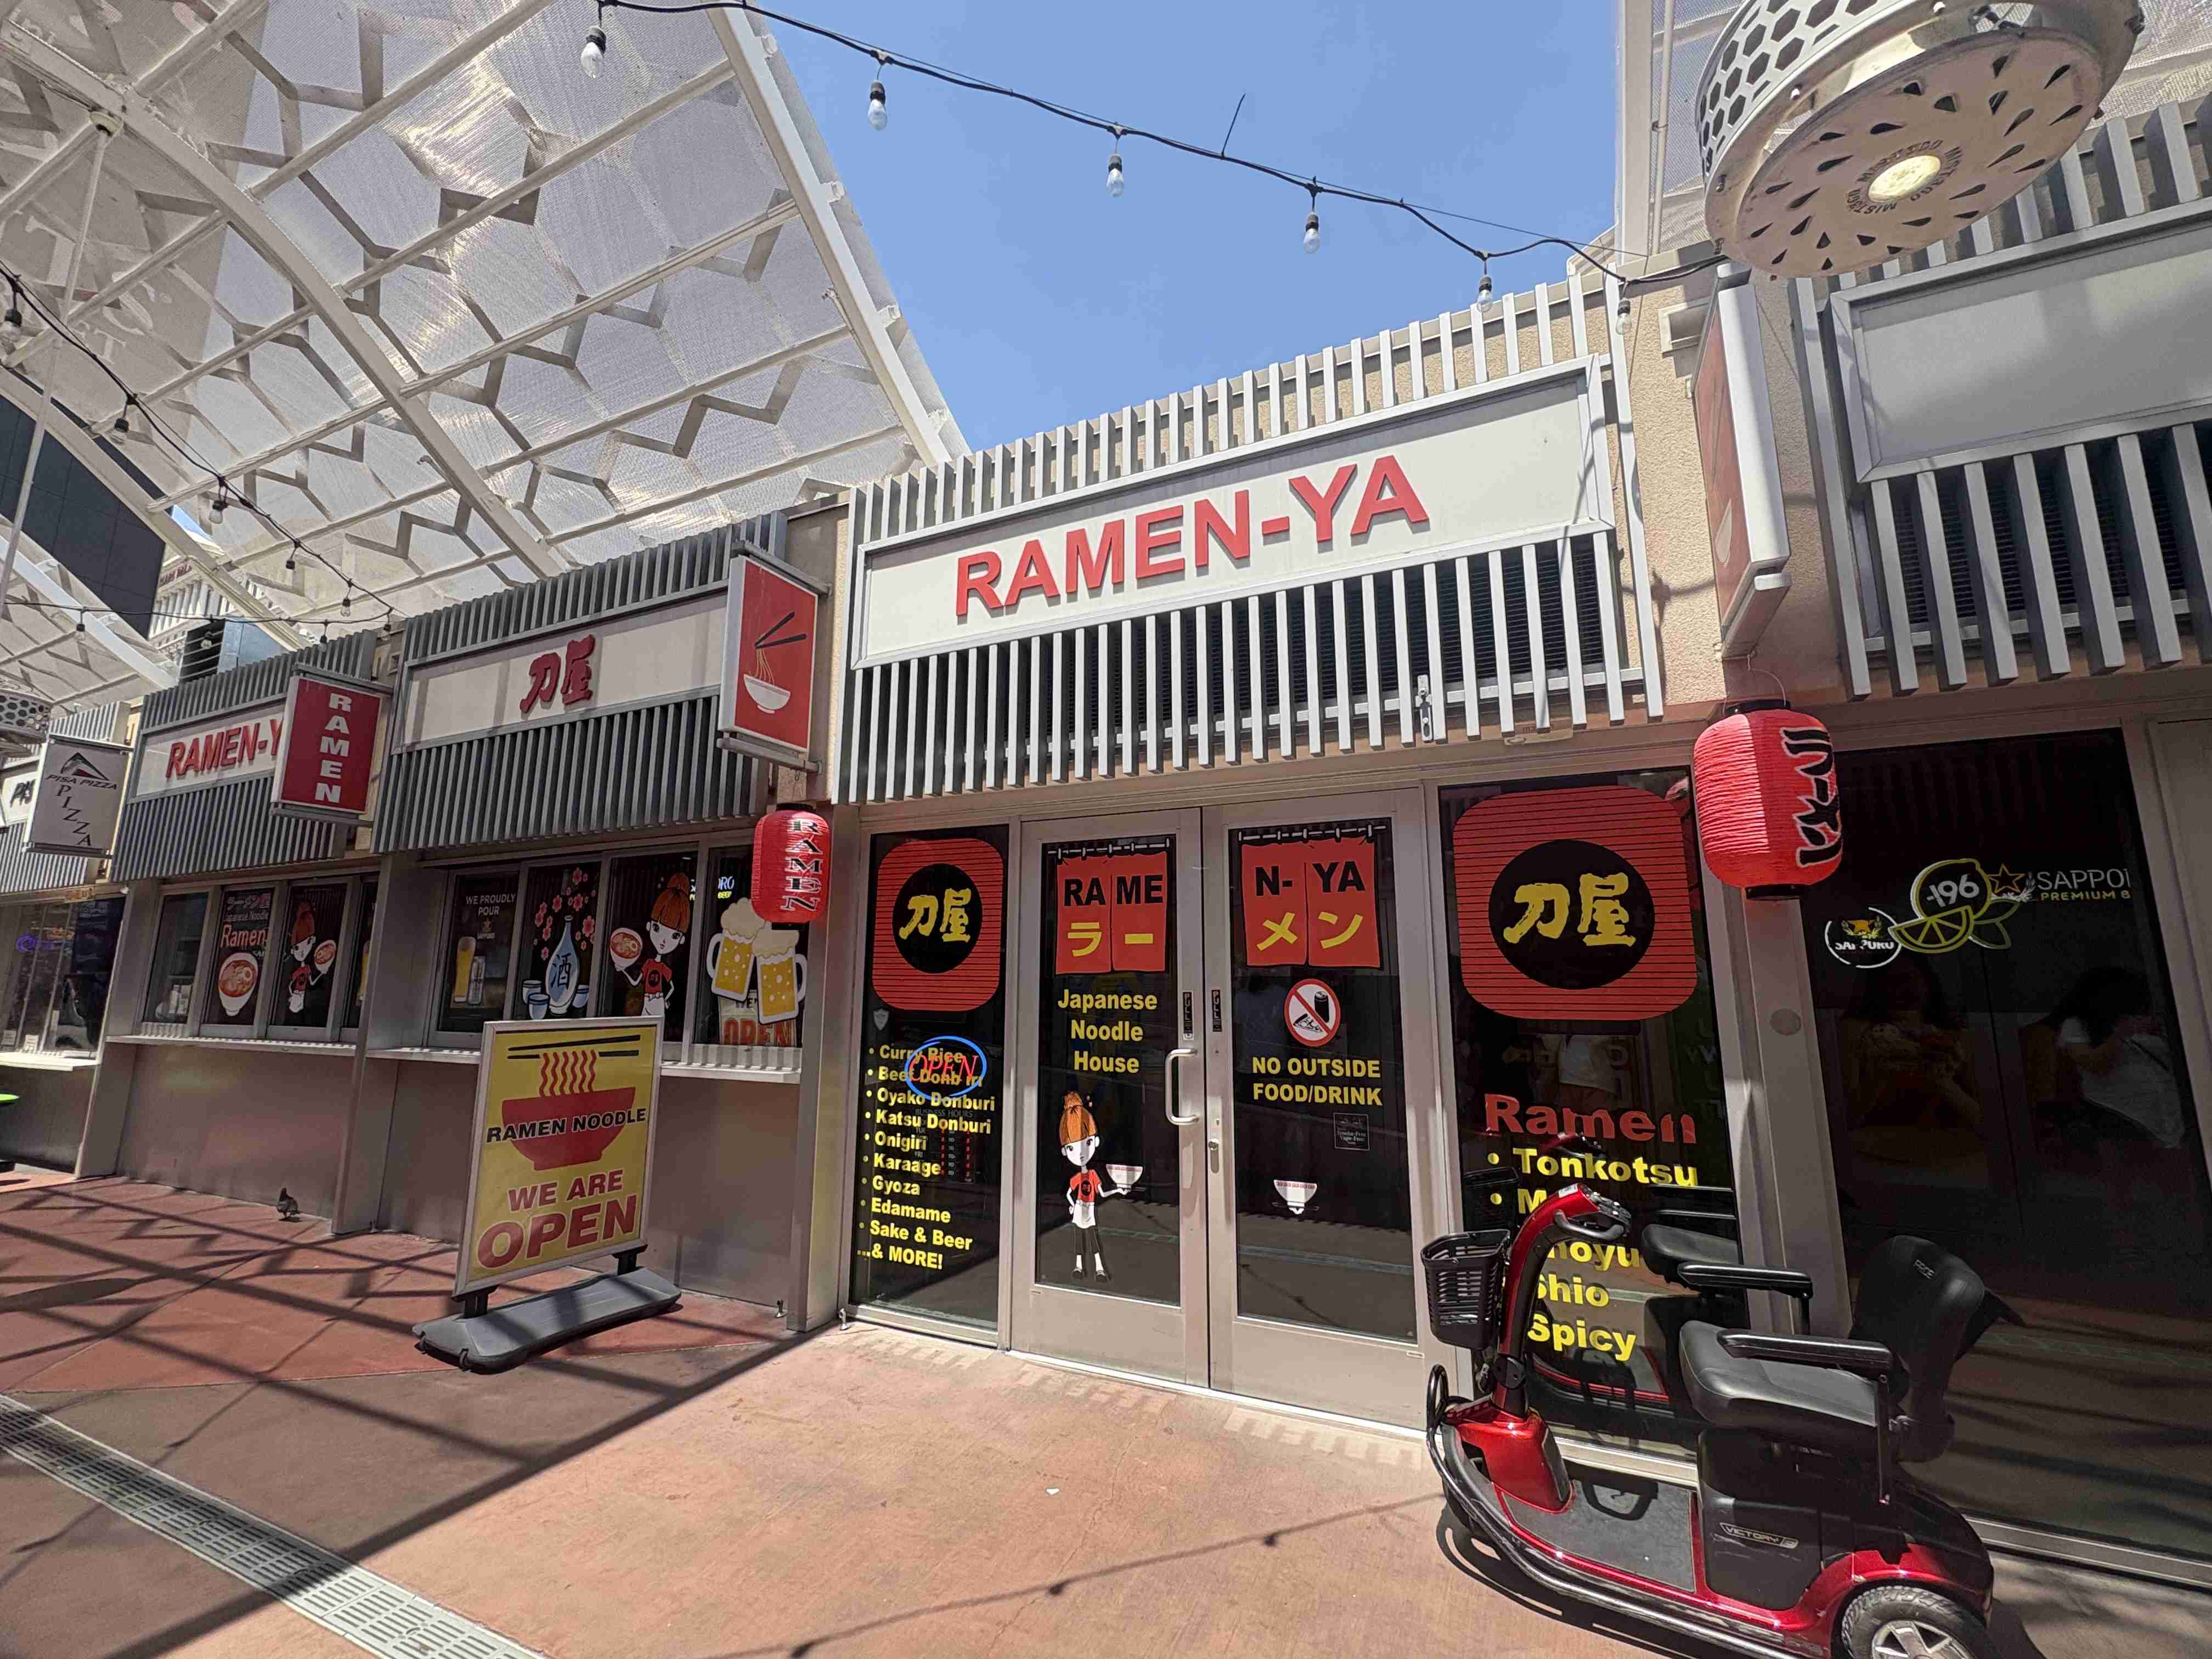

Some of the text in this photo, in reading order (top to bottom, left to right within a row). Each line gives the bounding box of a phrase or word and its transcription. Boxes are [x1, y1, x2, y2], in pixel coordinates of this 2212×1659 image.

[955, 454, 1430, 617] RAMEN-YA
[520, 634, 596, 714] 刀屋
[315, 692, 352, 804] RAMEN
[46, 774, 117, 790] PISA PIZZA
[55, 785, 92, 847] PIZZA
[780, 817, 824, 911] RAMEN
[466, 893, 516, 905] WE PROUDLY
[2040, 890, 2116, 901] PREMIUM
[478, 906, 500, 916] POUR
[899, 888, 972, 943] 刀屋
[1503, 872, 1636, 947] 刀屋
[220, 924, 267, 949] Ramen
[550, 952, 572, 987] 酒
[1057, 989, 1158, 1013] Japanese
[1070, 1019, 1144, 1042] Noodle
[879, 1044, 963, 1064] Curry Rice
[1073, 1051, 1140, 1074] House
[878, 1066, 914, 1081] Beef
[909, 1055, 980, 1082] OPEN
[1252, 1057, 1381, 1079] NO OUTSIDE
[877, 1087, 995, 1111] Oyako Donburi
[1252, 1083, 1383, 1107] FOOD/DRINK
[486, 1108, 647, 1143] RAMEN NOODLE
[876, 1109, 991, 1134] Katsu Donburi
[947, 1109, 974, 1118] HOURS
[1485, 1093, 1697, 1144] Ramen
[874, 1131, 927, 1152] Onigiri
[873, 1153, 941, 1177] Karaage
[1513, 1147, 1699, 1187] Tonkotsu
[507, 1169, 623, 1212] WE ARE
[872, 1175, 921, 1196] Gyoza
[871, 1197, 951, 1223] Edamame
[476, 1194, 637, 1269] OPEN
[870, 1220, 973, 1250] Sake & Beer
[889, 1245, 943, 1270] MORE!
[1527, 1313, 1638, 1362] Spicy
[1725, 1526, 1779, 1543] VICTORY
